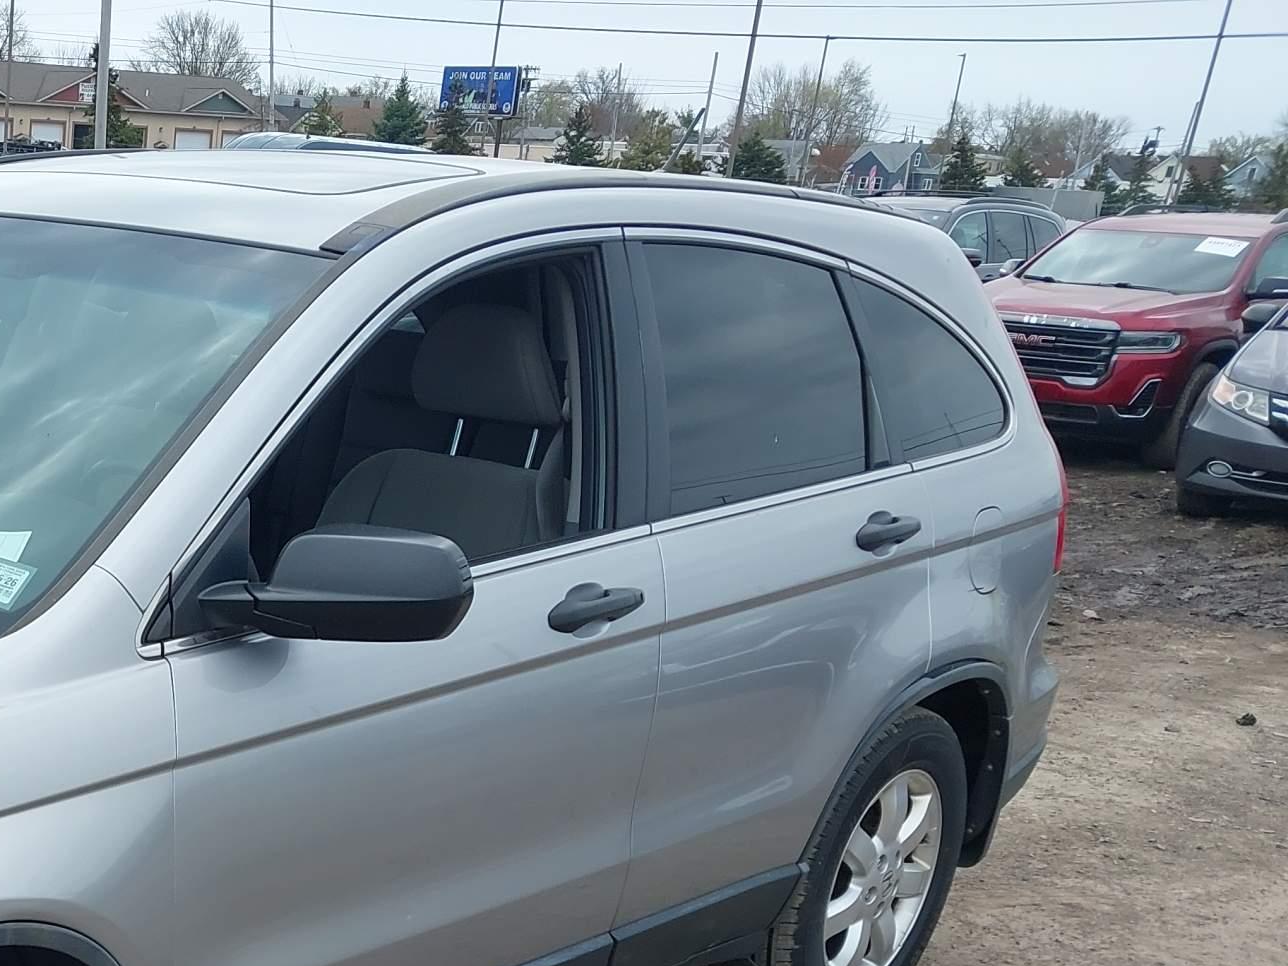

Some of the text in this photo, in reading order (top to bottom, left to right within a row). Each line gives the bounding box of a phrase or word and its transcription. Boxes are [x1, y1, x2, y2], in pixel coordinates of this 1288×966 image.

[449, 71, 511, 81] JOIN OUR EAM
